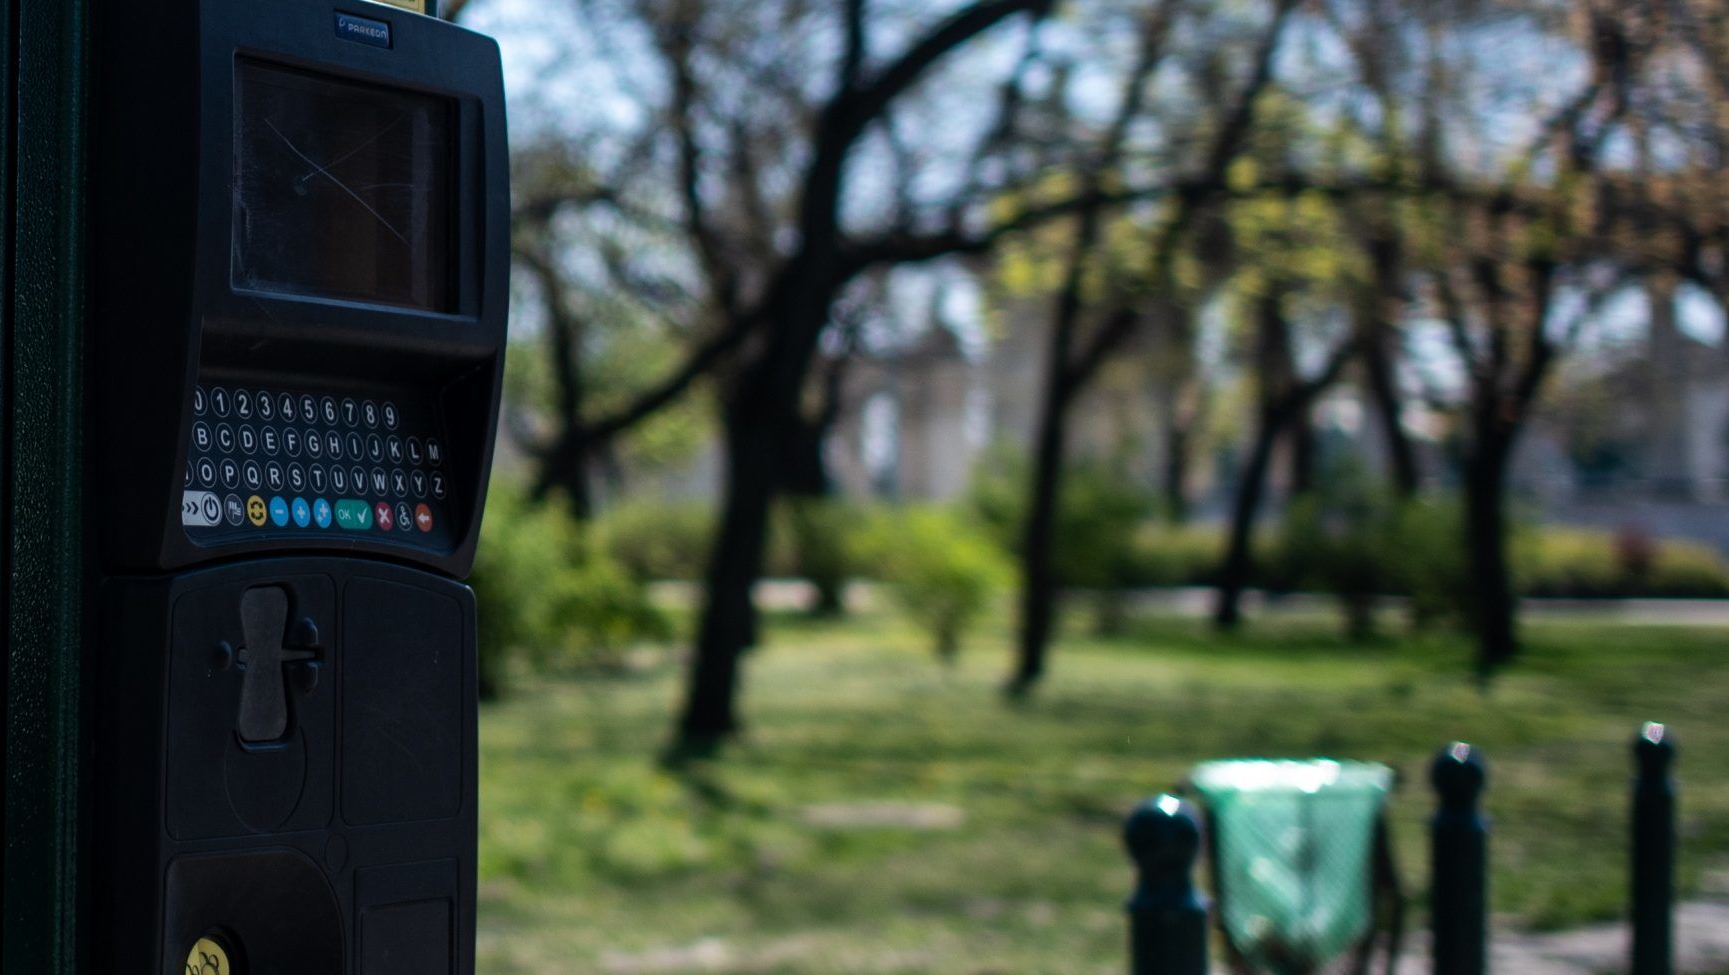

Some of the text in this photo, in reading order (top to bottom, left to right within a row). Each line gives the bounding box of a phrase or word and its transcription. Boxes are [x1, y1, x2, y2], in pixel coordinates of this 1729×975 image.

[238, 395, 248, 414] 2
[261, 396, 270, 415] 3
[283, 398, 292, 417] 4
[305, 400, 313, 418] 5
[325, 402, 334, 420] 6
[345, 404, 353, 422] 7
[366, 405, 375, 423] 8
[386, 407, 394, 425] 9
[197, 428, 439, 460] B C D E F G H J K L M
[202, 464, 443, 493] O P Q R S T U V W X Y Z
[339, 509, 351, 520] OK
